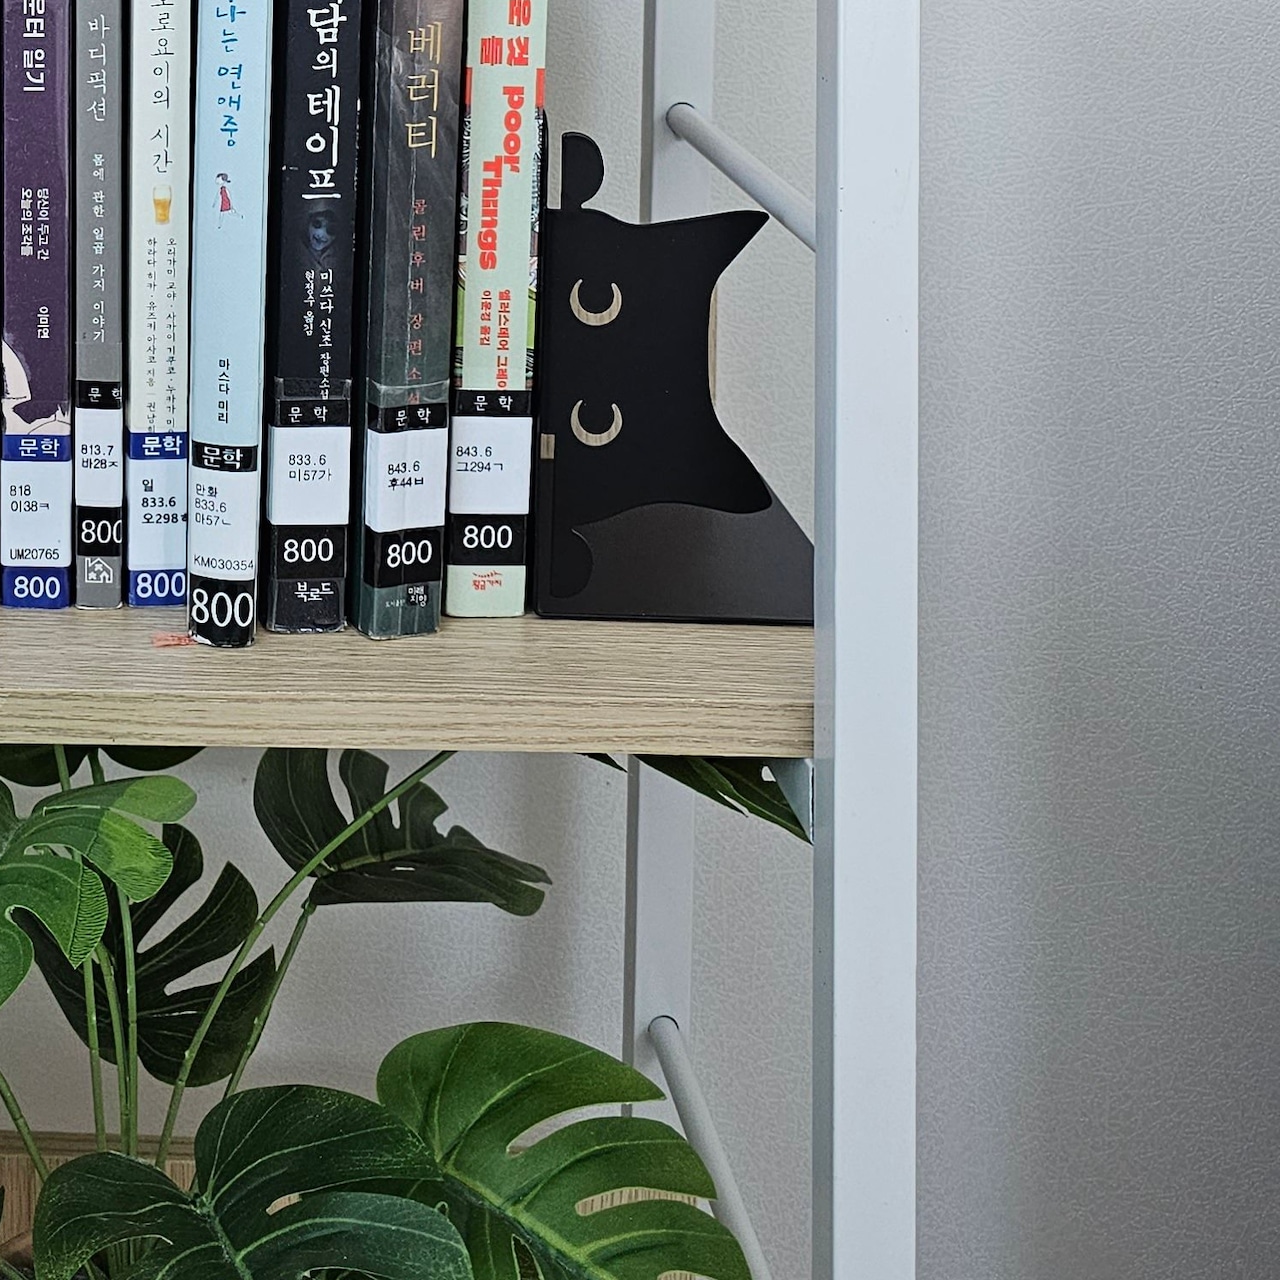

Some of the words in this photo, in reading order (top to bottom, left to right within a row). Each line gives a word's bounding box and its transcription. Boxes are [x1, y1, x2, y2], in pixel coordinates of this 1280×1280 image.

[23, 49, 45, 92] 일기
[87, 14, 111, 122] 바디픽션
[405, 21, 443, 159] 베러티
[150, 124, 173, 174] 시간
[301, 84, 342, 200] 테이프
[92, 153, 105, 182] 몸에
[21, 188, 33, 220] 오늘의
[37, 188, 49, 220] 당신이
[92, 190, 106, 219] 관한
[37, 223, 49, 246] 두고
[92, 226, 105, 255] 일곱
[37, 249, 49, 260] 간
[147, 237, 157, 268] 하라다
[166, 237, 177, 278] 오리가미
[92, 263, 106, 292] 가지
[166, 281, 177, 301] 고야
[320, 268, 335, 315] 미쓰다
[37, 306, 49, 339] 이미연
[92, 300, 105, 343] 이야기
[147, 301, 157, 332] 유즈키
[319, 317, 333, 348] 신조
[147, 334, 157, 364] 아사코
[218, 358, 230, 395] 마스다
[218, 400, 229, 424] 미리
[19, 438, 61, 458] 문학
[81, 445, 114, 456] 813.7
[142, 435, 183, 456] 문학
[201, 446, 244, 470] 문학
[456, 446, 493, 458] 843.6
[288, 454, 327, 466] 833.6
[388, 460, 421, 475] 843.6
[9, 485, 32, 497] 818
[142, 479, 154, 493] 일
[195, 483, 218, 498] 만화
[141, 496, 177, 508] 833.6
[194, 499, 227, 514] 833.6
[81, 519, 122, 544] 800
[463, 525, 513, 549] 800
[9, 548, 60, 561] UM20765
[193, 554, 254, 571] KM030354
[283, 538, 334, 563] 800
[386, 539, 433, 568] 800
[13, 575, 61, 599] 800
[136, 572, 186, 598] 800
[294, 582, 335, 603] 북로드
[191, 587, 255, 628] 800
